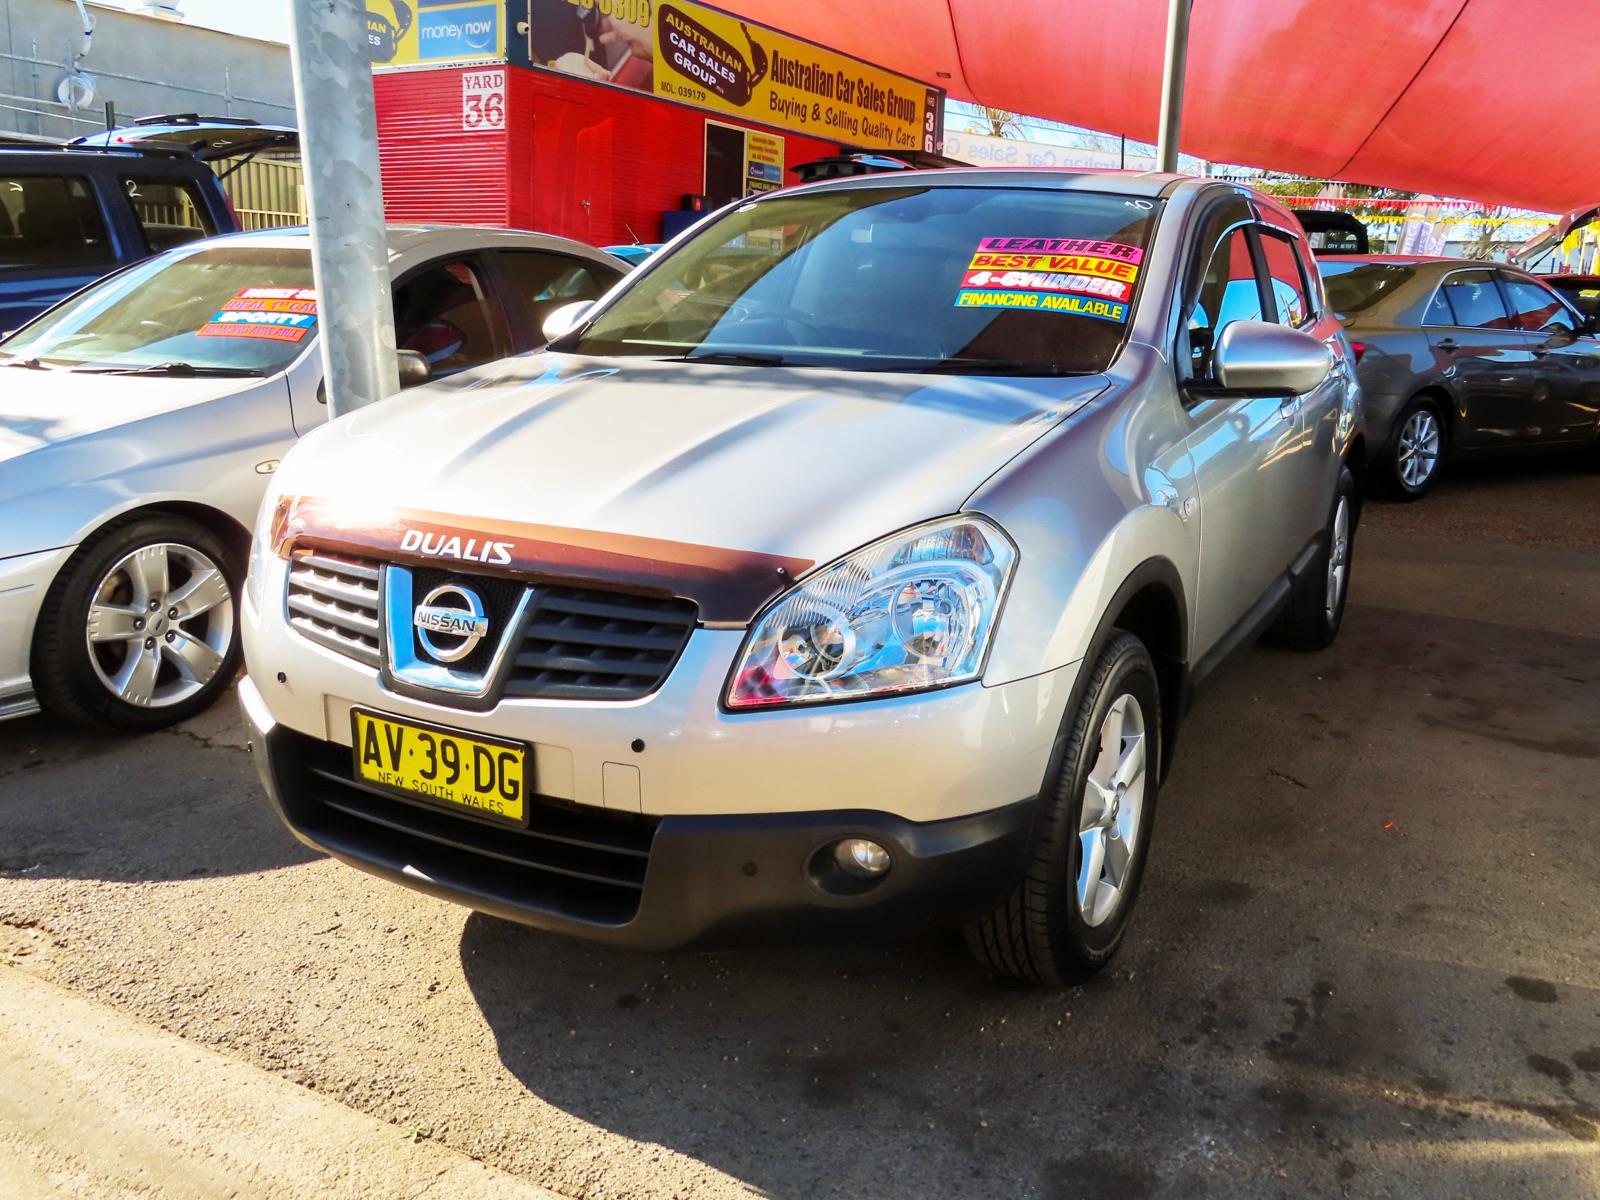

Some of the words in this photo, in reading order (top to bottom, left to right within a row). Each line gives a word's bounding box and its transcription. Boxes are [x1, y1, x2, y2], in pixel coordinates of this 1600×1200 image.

[421, 23, 464, 40] money
[464, 20, 492, 35] now
[665, 13, 742, 72] AUSTRALIAN
[669, 32, 696, 57] CAR
[698, 51, 736, 84] SALES
[673, 52, 717, 86] GROUP
[464, 74, 504, 89] YARD
[678, 86, 706, 102] 039179
[770, 49, 834, 99] Australian
[836, 70, 856, 104] Car
[856, 78, 886, 114] Sales
[886, 87, 916, 126] Group
[464, 92, 504, 128] 36
[769, 90, 808, 123] Buying
[811, 103, 821, 122] &
[825, 106, 859, 136] Selling
[861, 116, 894, 147] Quality
[895, 127, 916, 148] Cars
[985, 238, 1136, 259] LEATHER
[974, 255, 1044, 268] BEST
[1048, 256, 1133, 278] VALUE
[967, 271, 1127, 298] 4-CYLINDER
[959, 292, 1039, 307] FINANCING
[1040, 295, 1123, 319] AVAILABLE
[400, 529, 515, 565] DUALIS
[417, 610, 477, 632] NISSAN
[378, 771, 404, 788] NEW
[411, 779, 454, 801] SOUTH
[462, 791, 505, 815] WALES
